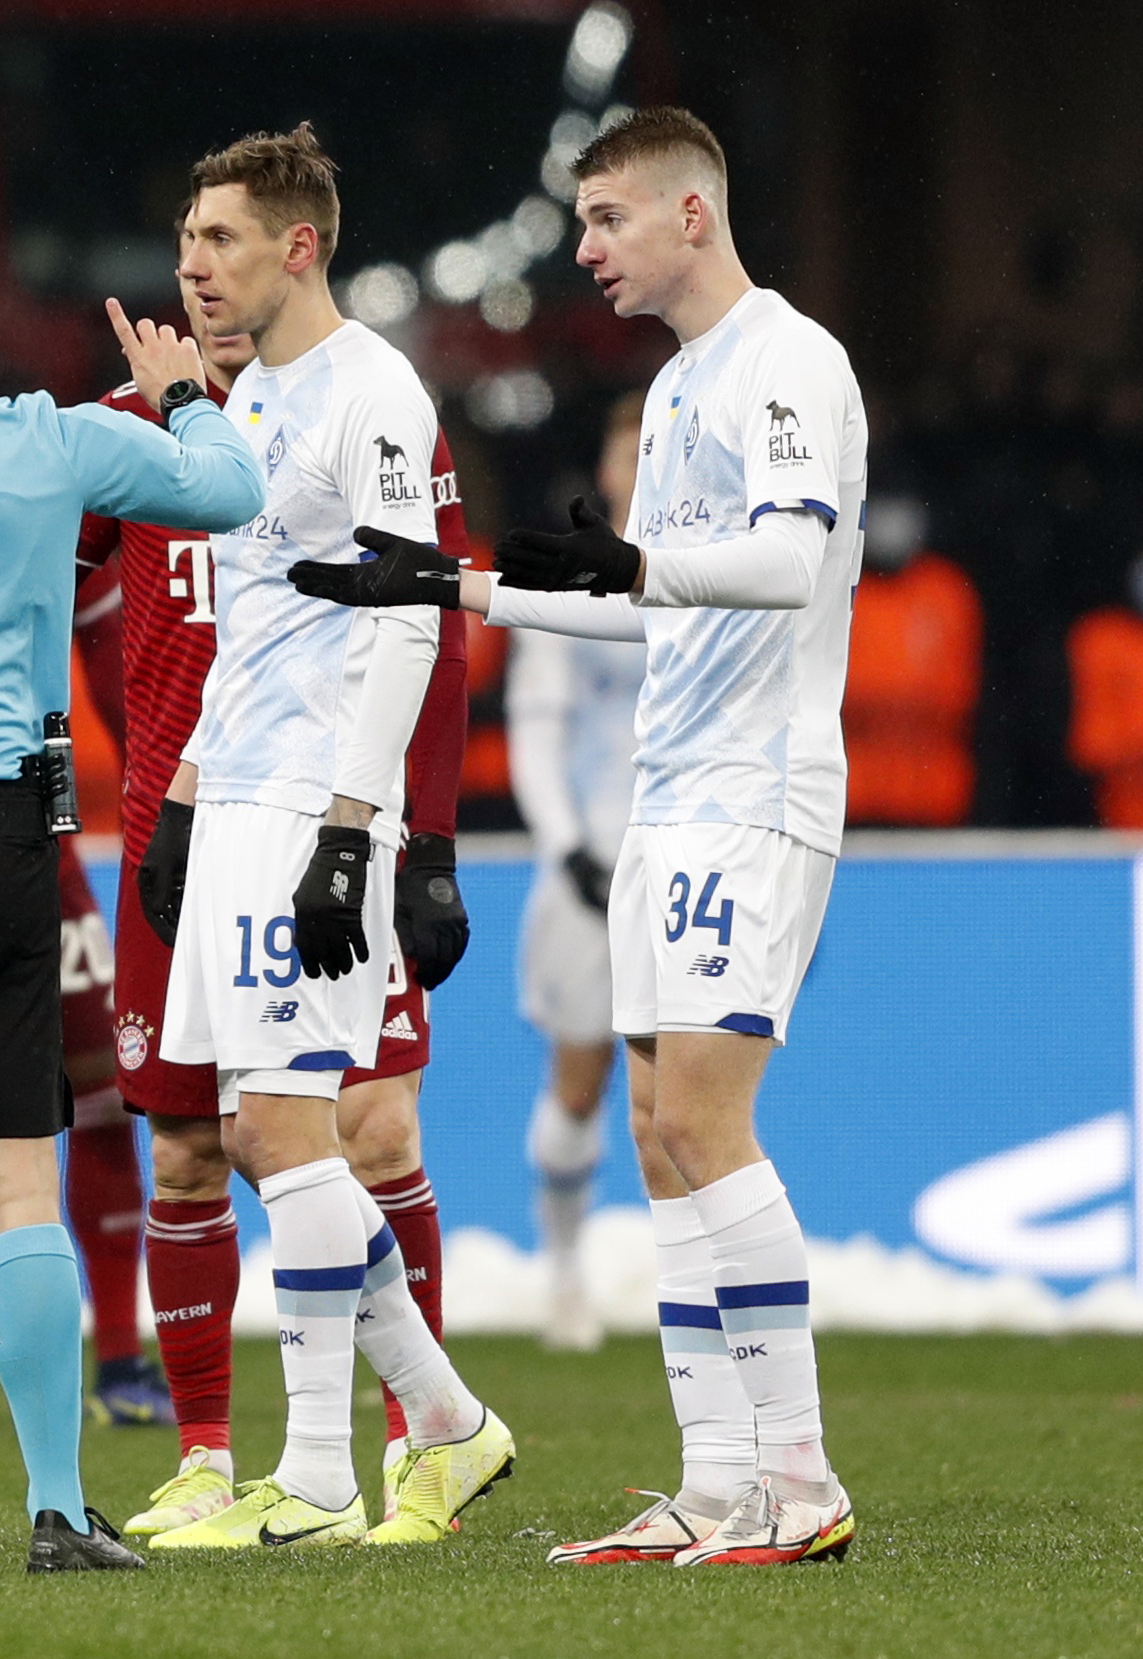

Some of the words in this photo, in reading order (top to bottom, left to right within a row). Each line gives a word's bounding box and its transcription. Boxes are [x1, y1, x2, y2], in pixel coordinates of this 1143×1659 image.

[768, 432, 795, 450] PIT
[769, 446, 813, 462] BULL
[379, 471, 405, 487] PIT
[381, 486, 422, 502] BULL
[664, 871, 734, 947] 34
[232, 915, 302, 989] 19
[381, 1027, 419, 1041] adidas
[155, 1302, 212, 1324] AYERN
[279, 1329, 305, 1346] DK
[666, 1366, 694, 1379] DK
